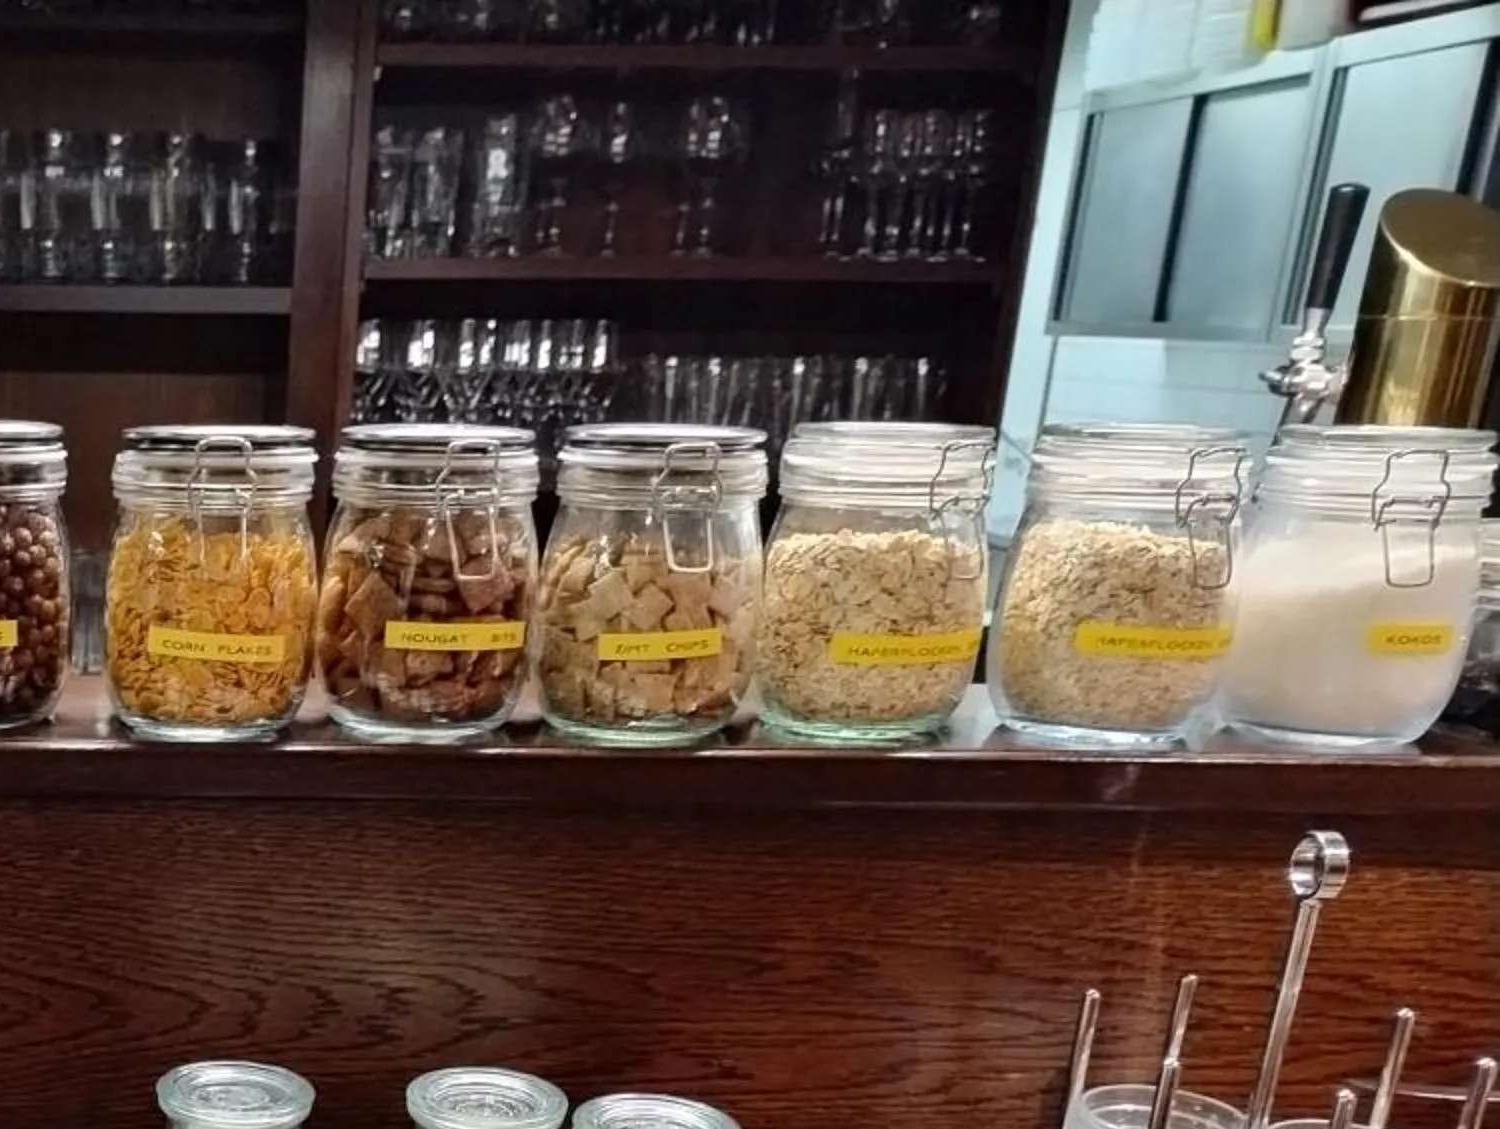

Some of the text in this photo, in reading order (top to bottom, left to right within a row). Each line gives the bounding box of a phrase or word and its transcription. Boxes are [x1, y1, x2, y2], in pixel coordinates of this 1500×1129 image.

[401, 632, 467, 644] NOUGAT
[162, 639, 272, 656] CORN FLAKES
